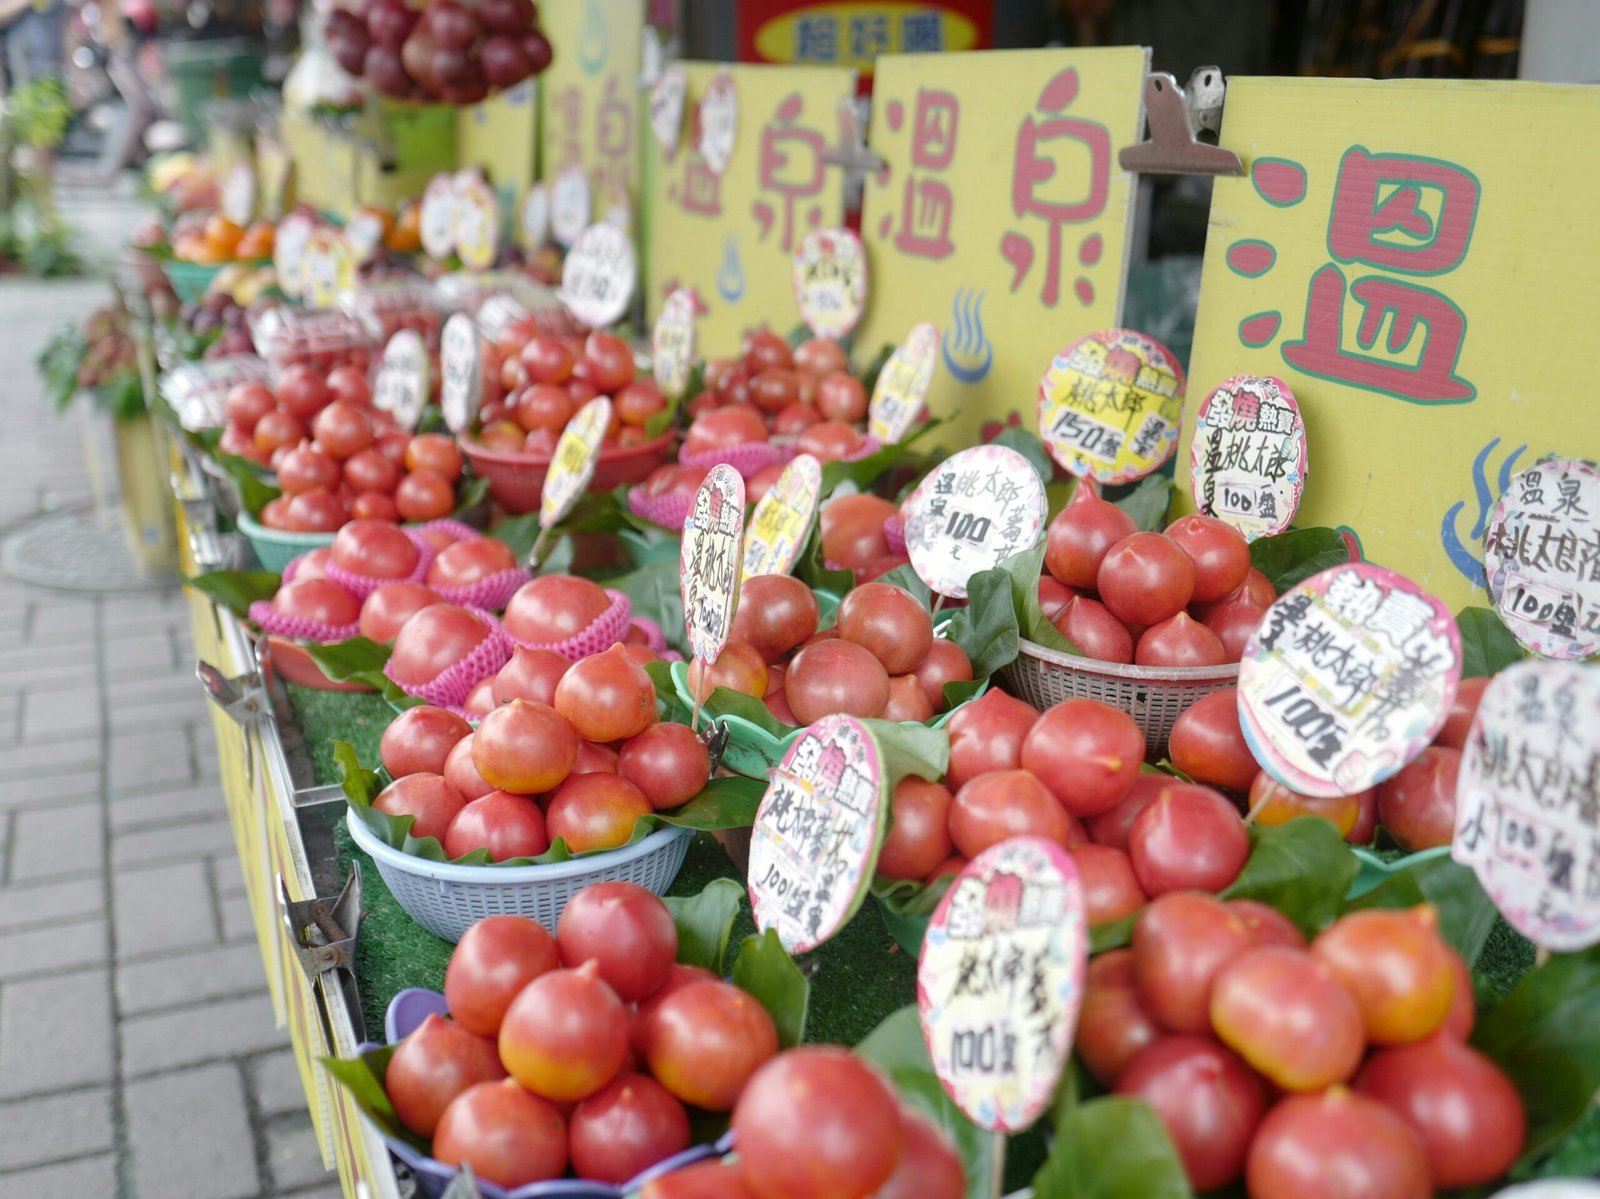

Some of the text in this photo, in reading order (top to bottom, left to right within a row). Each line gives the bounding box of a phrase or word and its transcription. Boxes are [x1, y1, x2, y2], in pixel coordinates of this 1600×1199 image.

[876, 67, 1112, 308] 溫泉
[1226, 144, 1482, 405] 溫
[1060, 378, 1147, 431] 桃太郎
[1206, 387, 1297, 435] 發燒熱賣
[1223, 434, 1286, 482] 桃太郎
[954, 465, 1024, 517] 桃太郎
[1520, 471, 1589, 516] 溫泉
[945, 511, 992, 542] 100
[1293, 621, 1378, 706] 桃太郎
